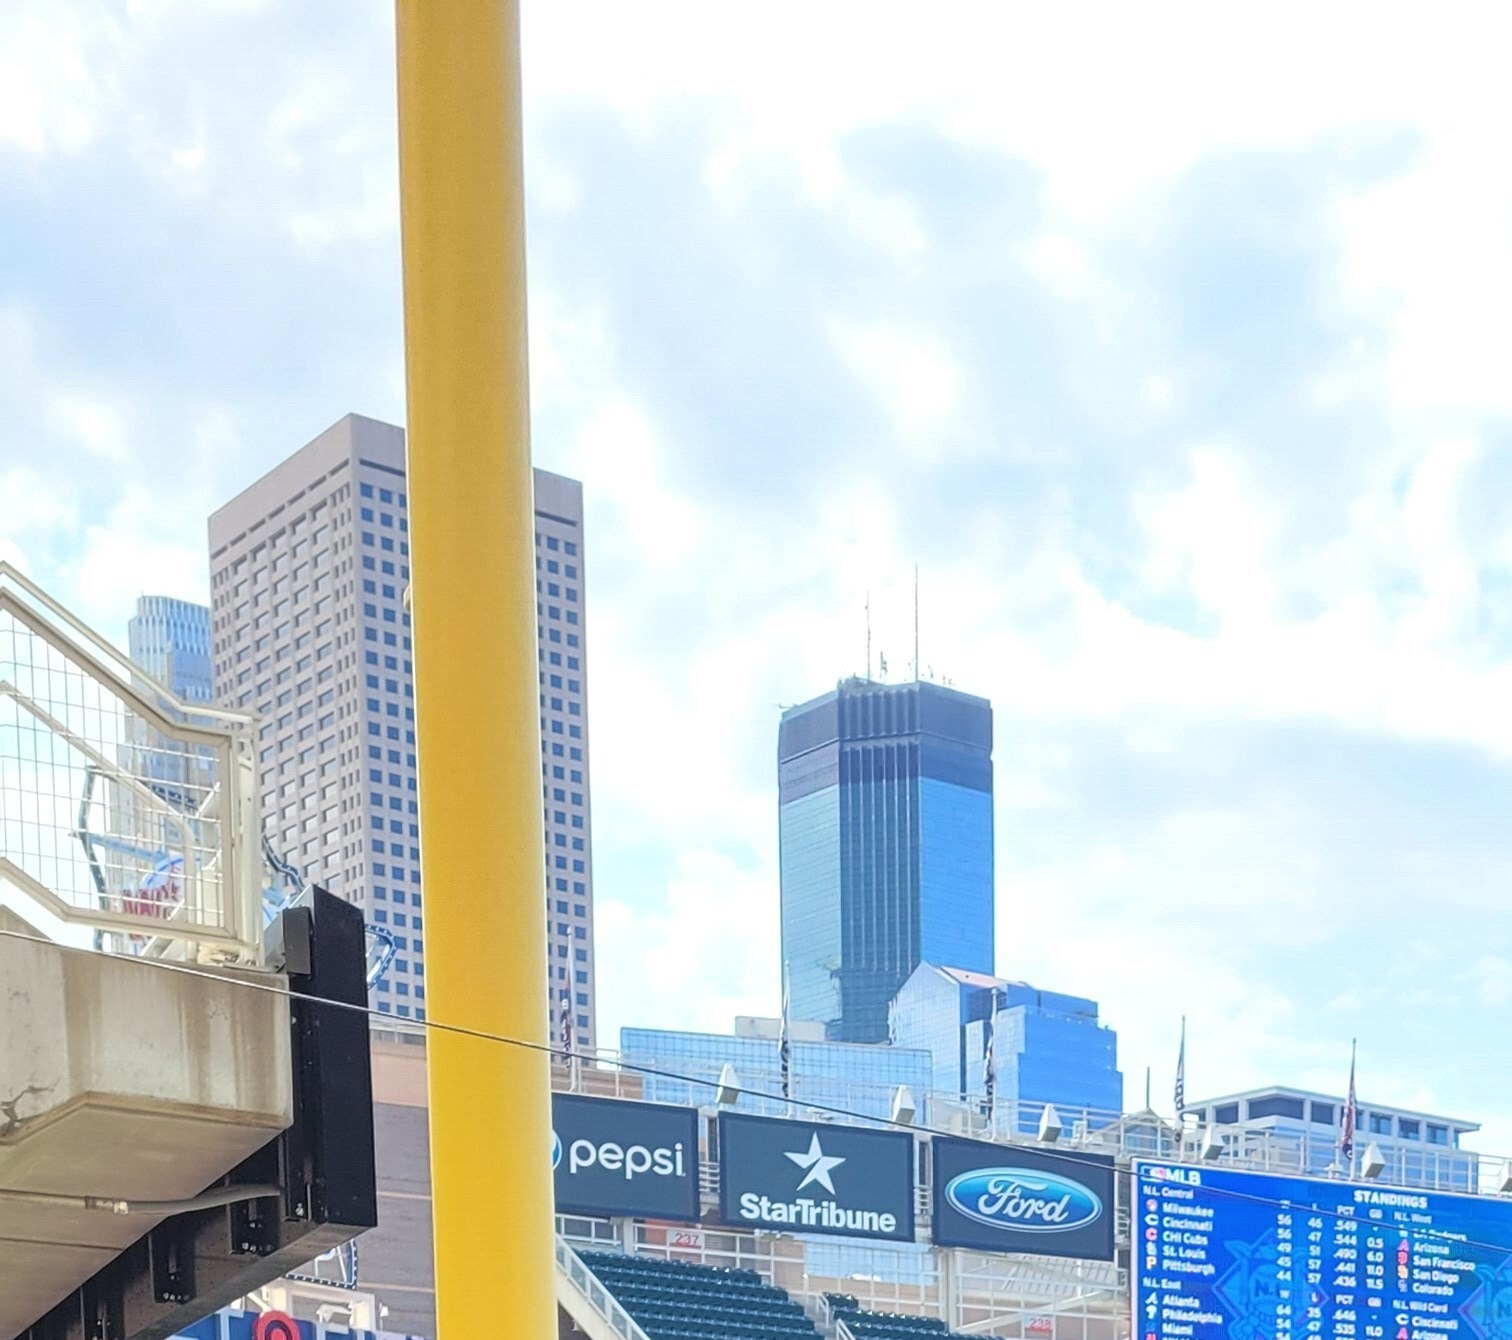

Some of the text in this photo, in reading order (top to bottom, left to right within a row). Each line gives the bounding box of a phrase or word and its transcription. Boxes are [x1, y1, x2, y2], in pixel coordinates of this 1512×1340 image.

[569, 1138, 684, 1180] pepsi
[1162, 1167, 1201, 1185] MLB
[977, 1176, 1072, 1223] Ford
[1353, 1189, 1428, 1209] STANDINGS
